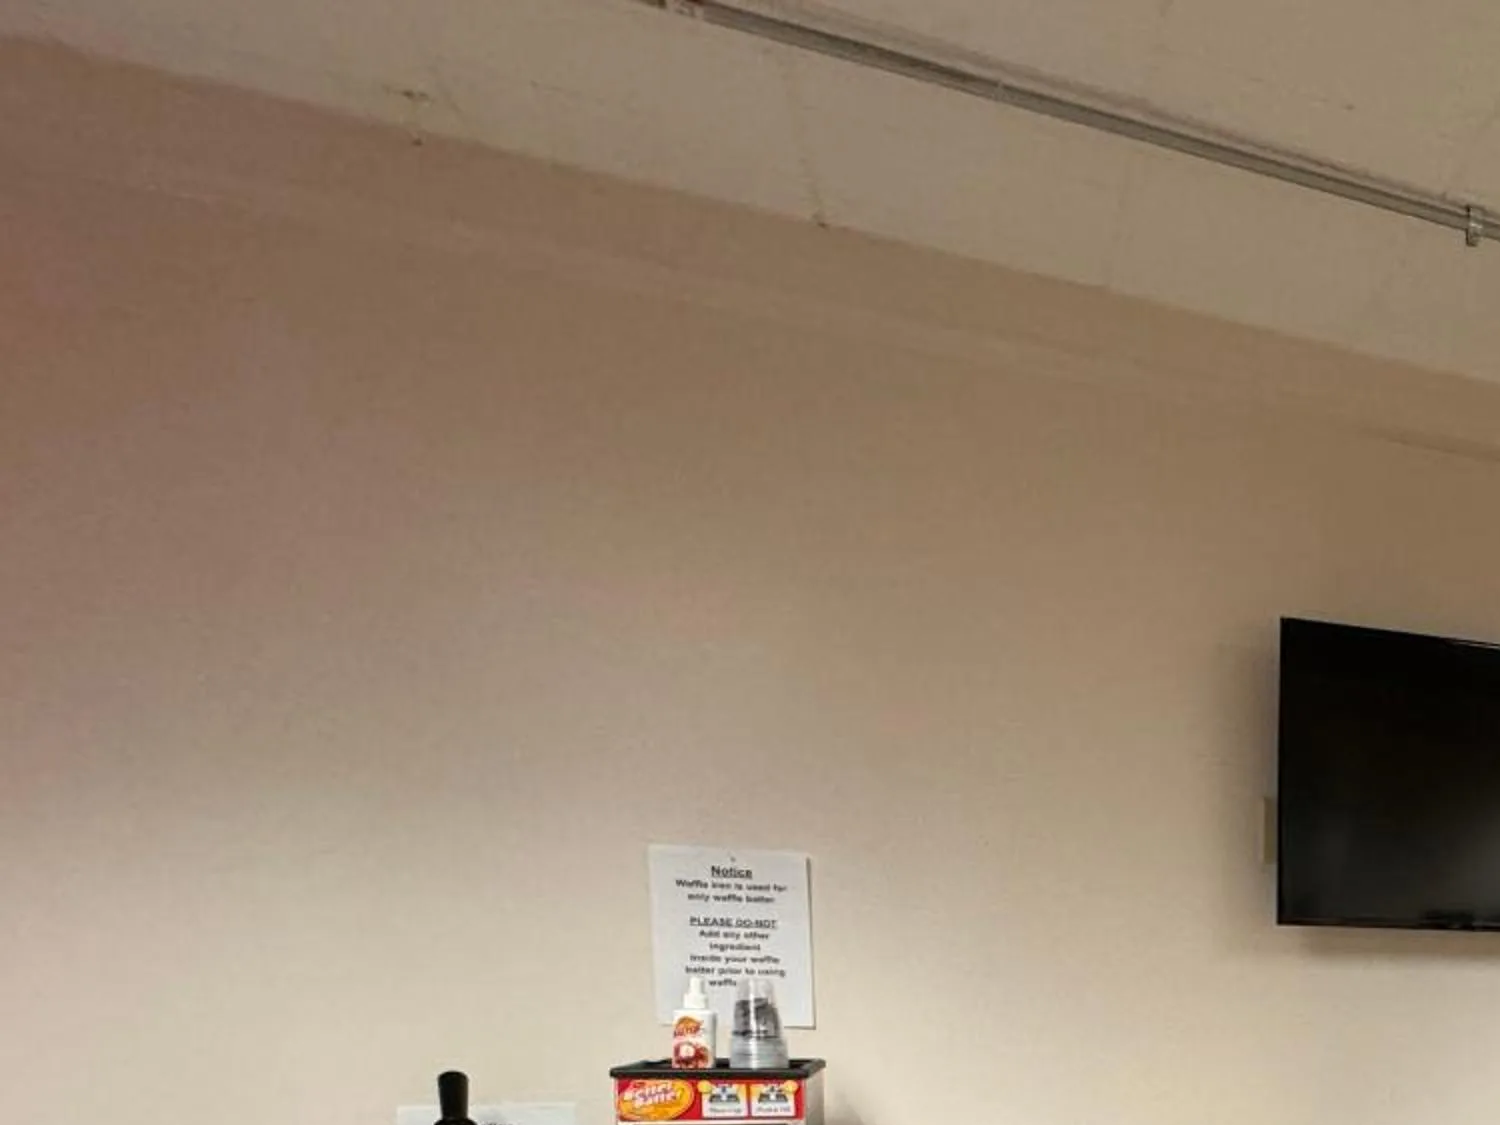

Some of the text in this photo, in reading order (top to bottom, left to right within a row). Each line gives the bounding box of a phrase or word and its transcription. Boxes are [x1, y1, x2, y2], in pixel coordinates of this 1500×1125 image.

[711, 865, 753, 879] Notice
[675, 879, 708, 890] Waffle
[746, 884, 771, 892] used
[773, 884, 787, 893] for
[712, 894, 743, 902] waffle
[689, 915, 733, 928] PLEASE
[700, 930, 769, 940] Add any other
[725, 957, 747, 965] your
[750, 955, 780, 964] waffle
[745, 968, 756, 976] to
[758, 970, 785, 978] using
